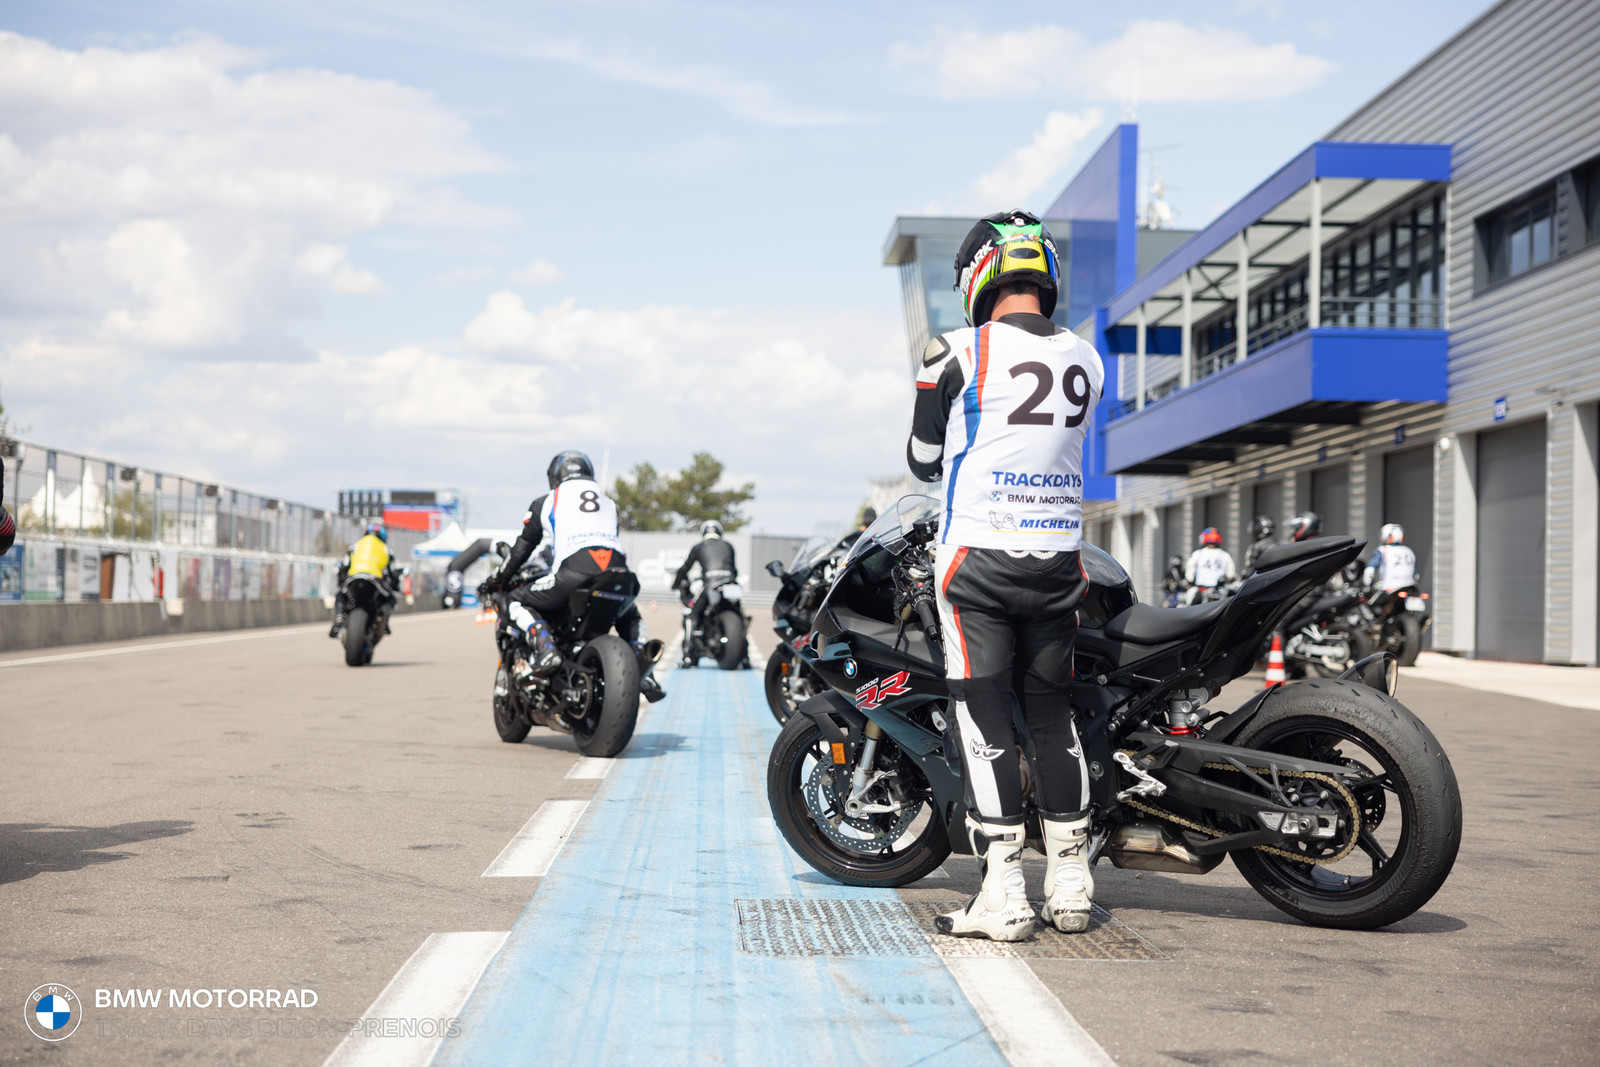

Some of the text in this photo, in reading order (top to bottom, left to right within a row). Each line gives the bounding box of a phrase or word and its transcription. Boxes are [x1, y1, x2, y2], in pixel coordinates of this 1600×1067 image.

[1007, 361, 1091, 428] 29
[992, 471, 1082, 488] TRACKDAYS
[579, 490, 600, 513] 8
[1008, 494, 1036, 504] BMW
[1019, 519, 1080, 529] MICHELIN
[855, 671, 913, 712] RR
